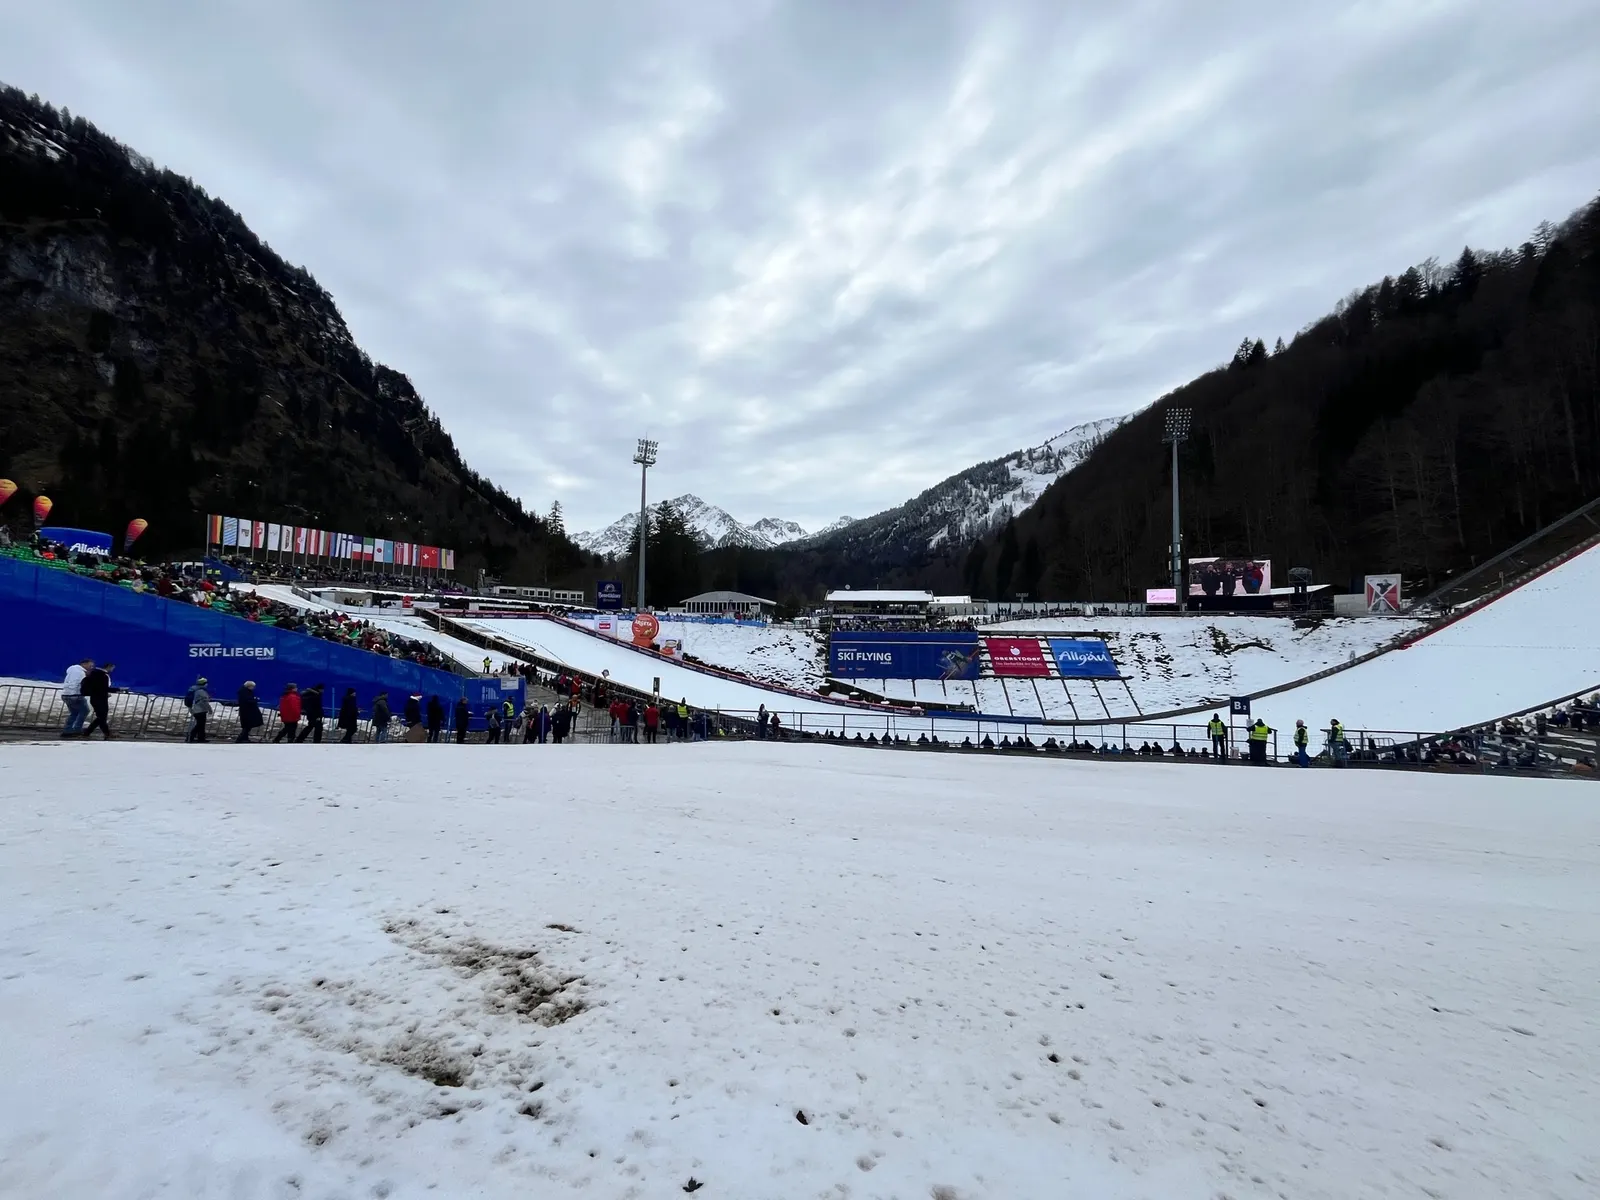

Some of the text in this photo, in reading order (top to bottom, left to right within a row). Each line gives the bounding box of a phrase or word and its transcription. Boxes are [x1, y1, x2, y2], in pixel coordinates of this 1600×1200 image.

[189, 647, 274, 657] SKIFLIEGEN
[837, 652, 892, 661] SKI FLYING
[1058, 650, 1108, 666] Allgäu
